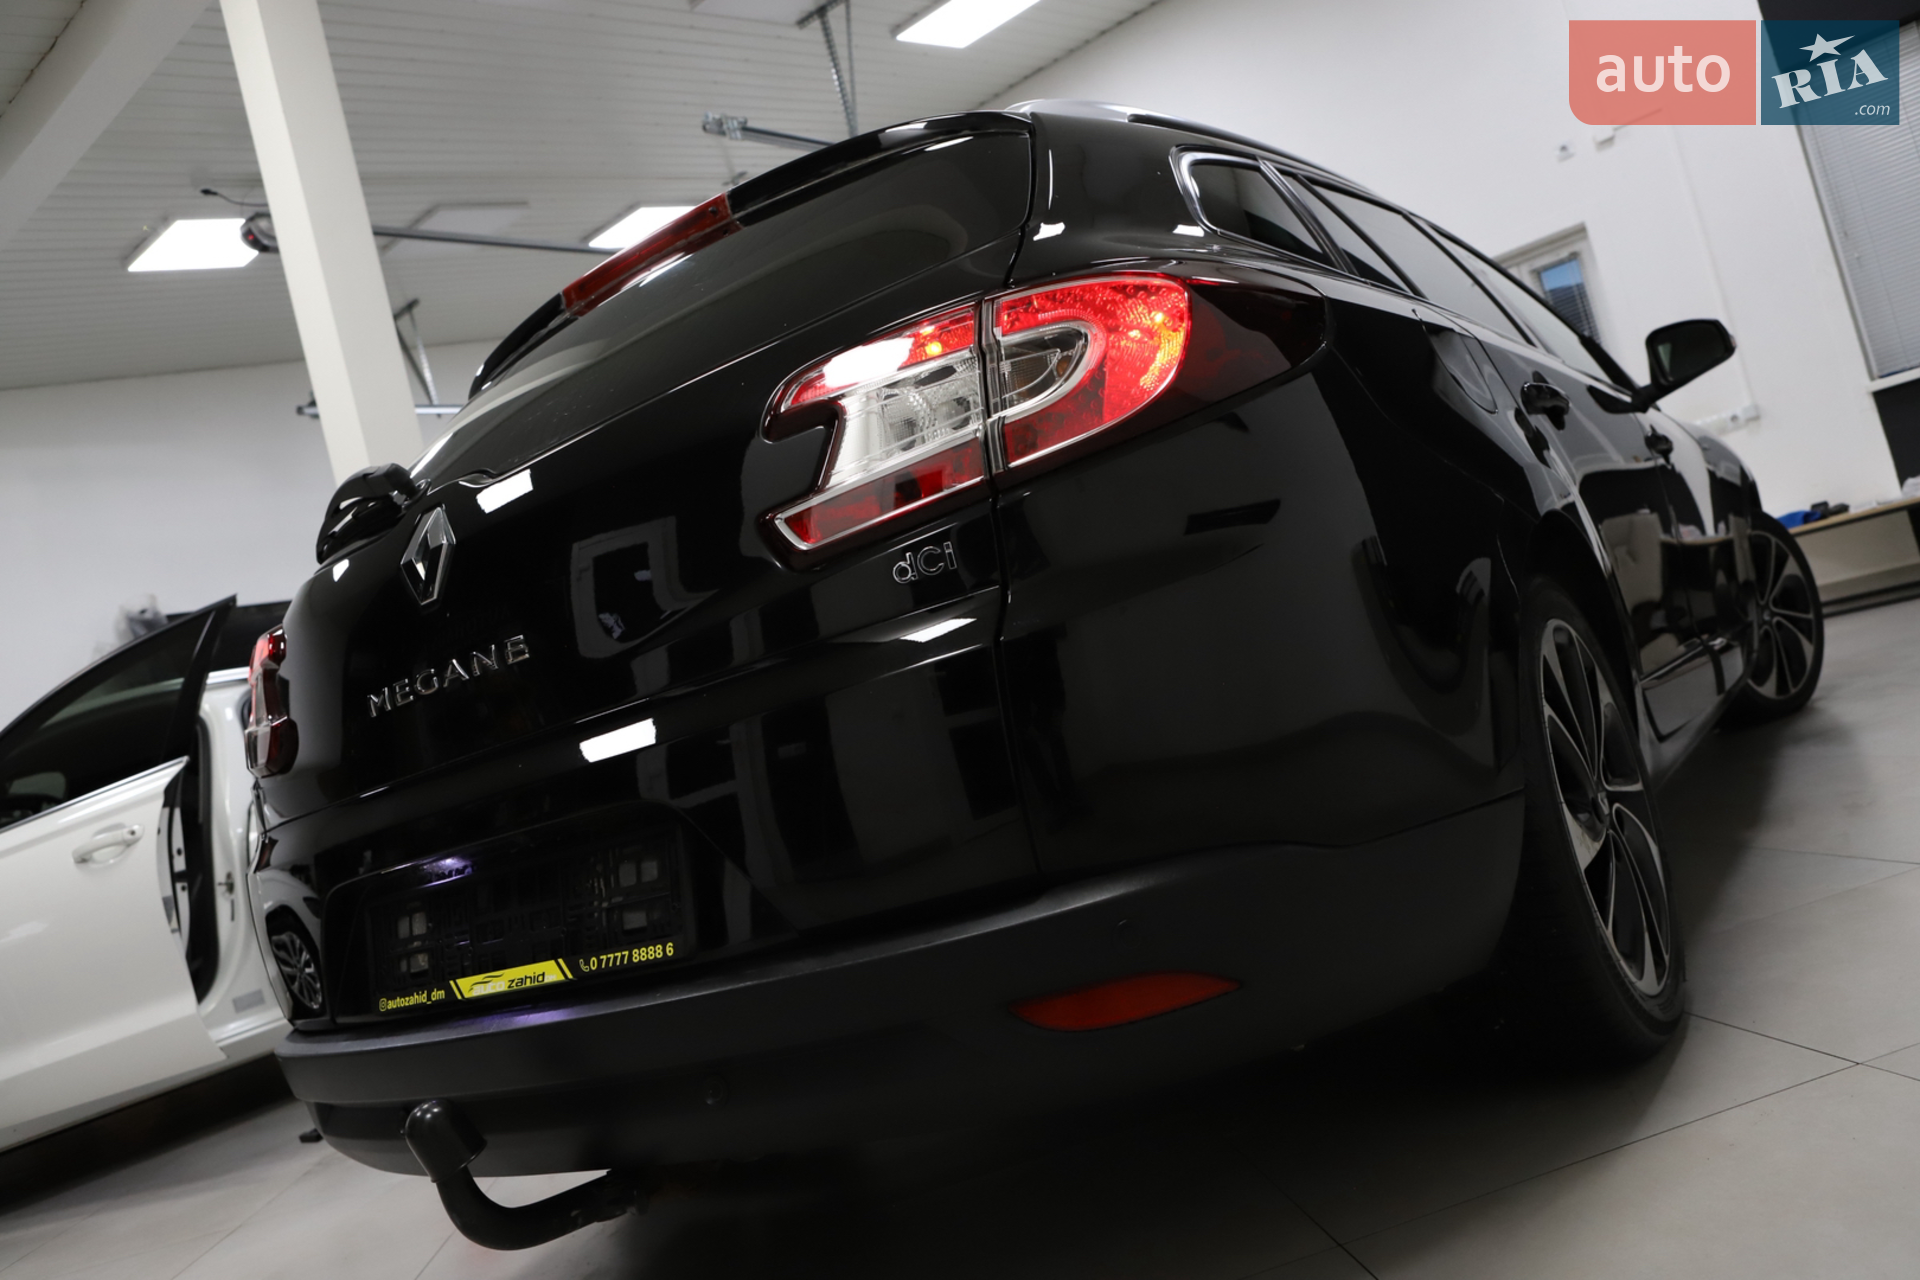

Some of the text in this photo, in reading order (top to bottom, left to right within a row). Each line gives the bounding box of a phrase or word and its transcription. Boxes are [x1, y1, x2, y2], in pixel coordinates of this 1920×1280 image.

[892, 541, 957, 584] dCi
[367, 634, 530, 718] MEGANE
[589, 941, 674, 971] 0 7777 8888 6
[507, 971, 546, 990] zahid
